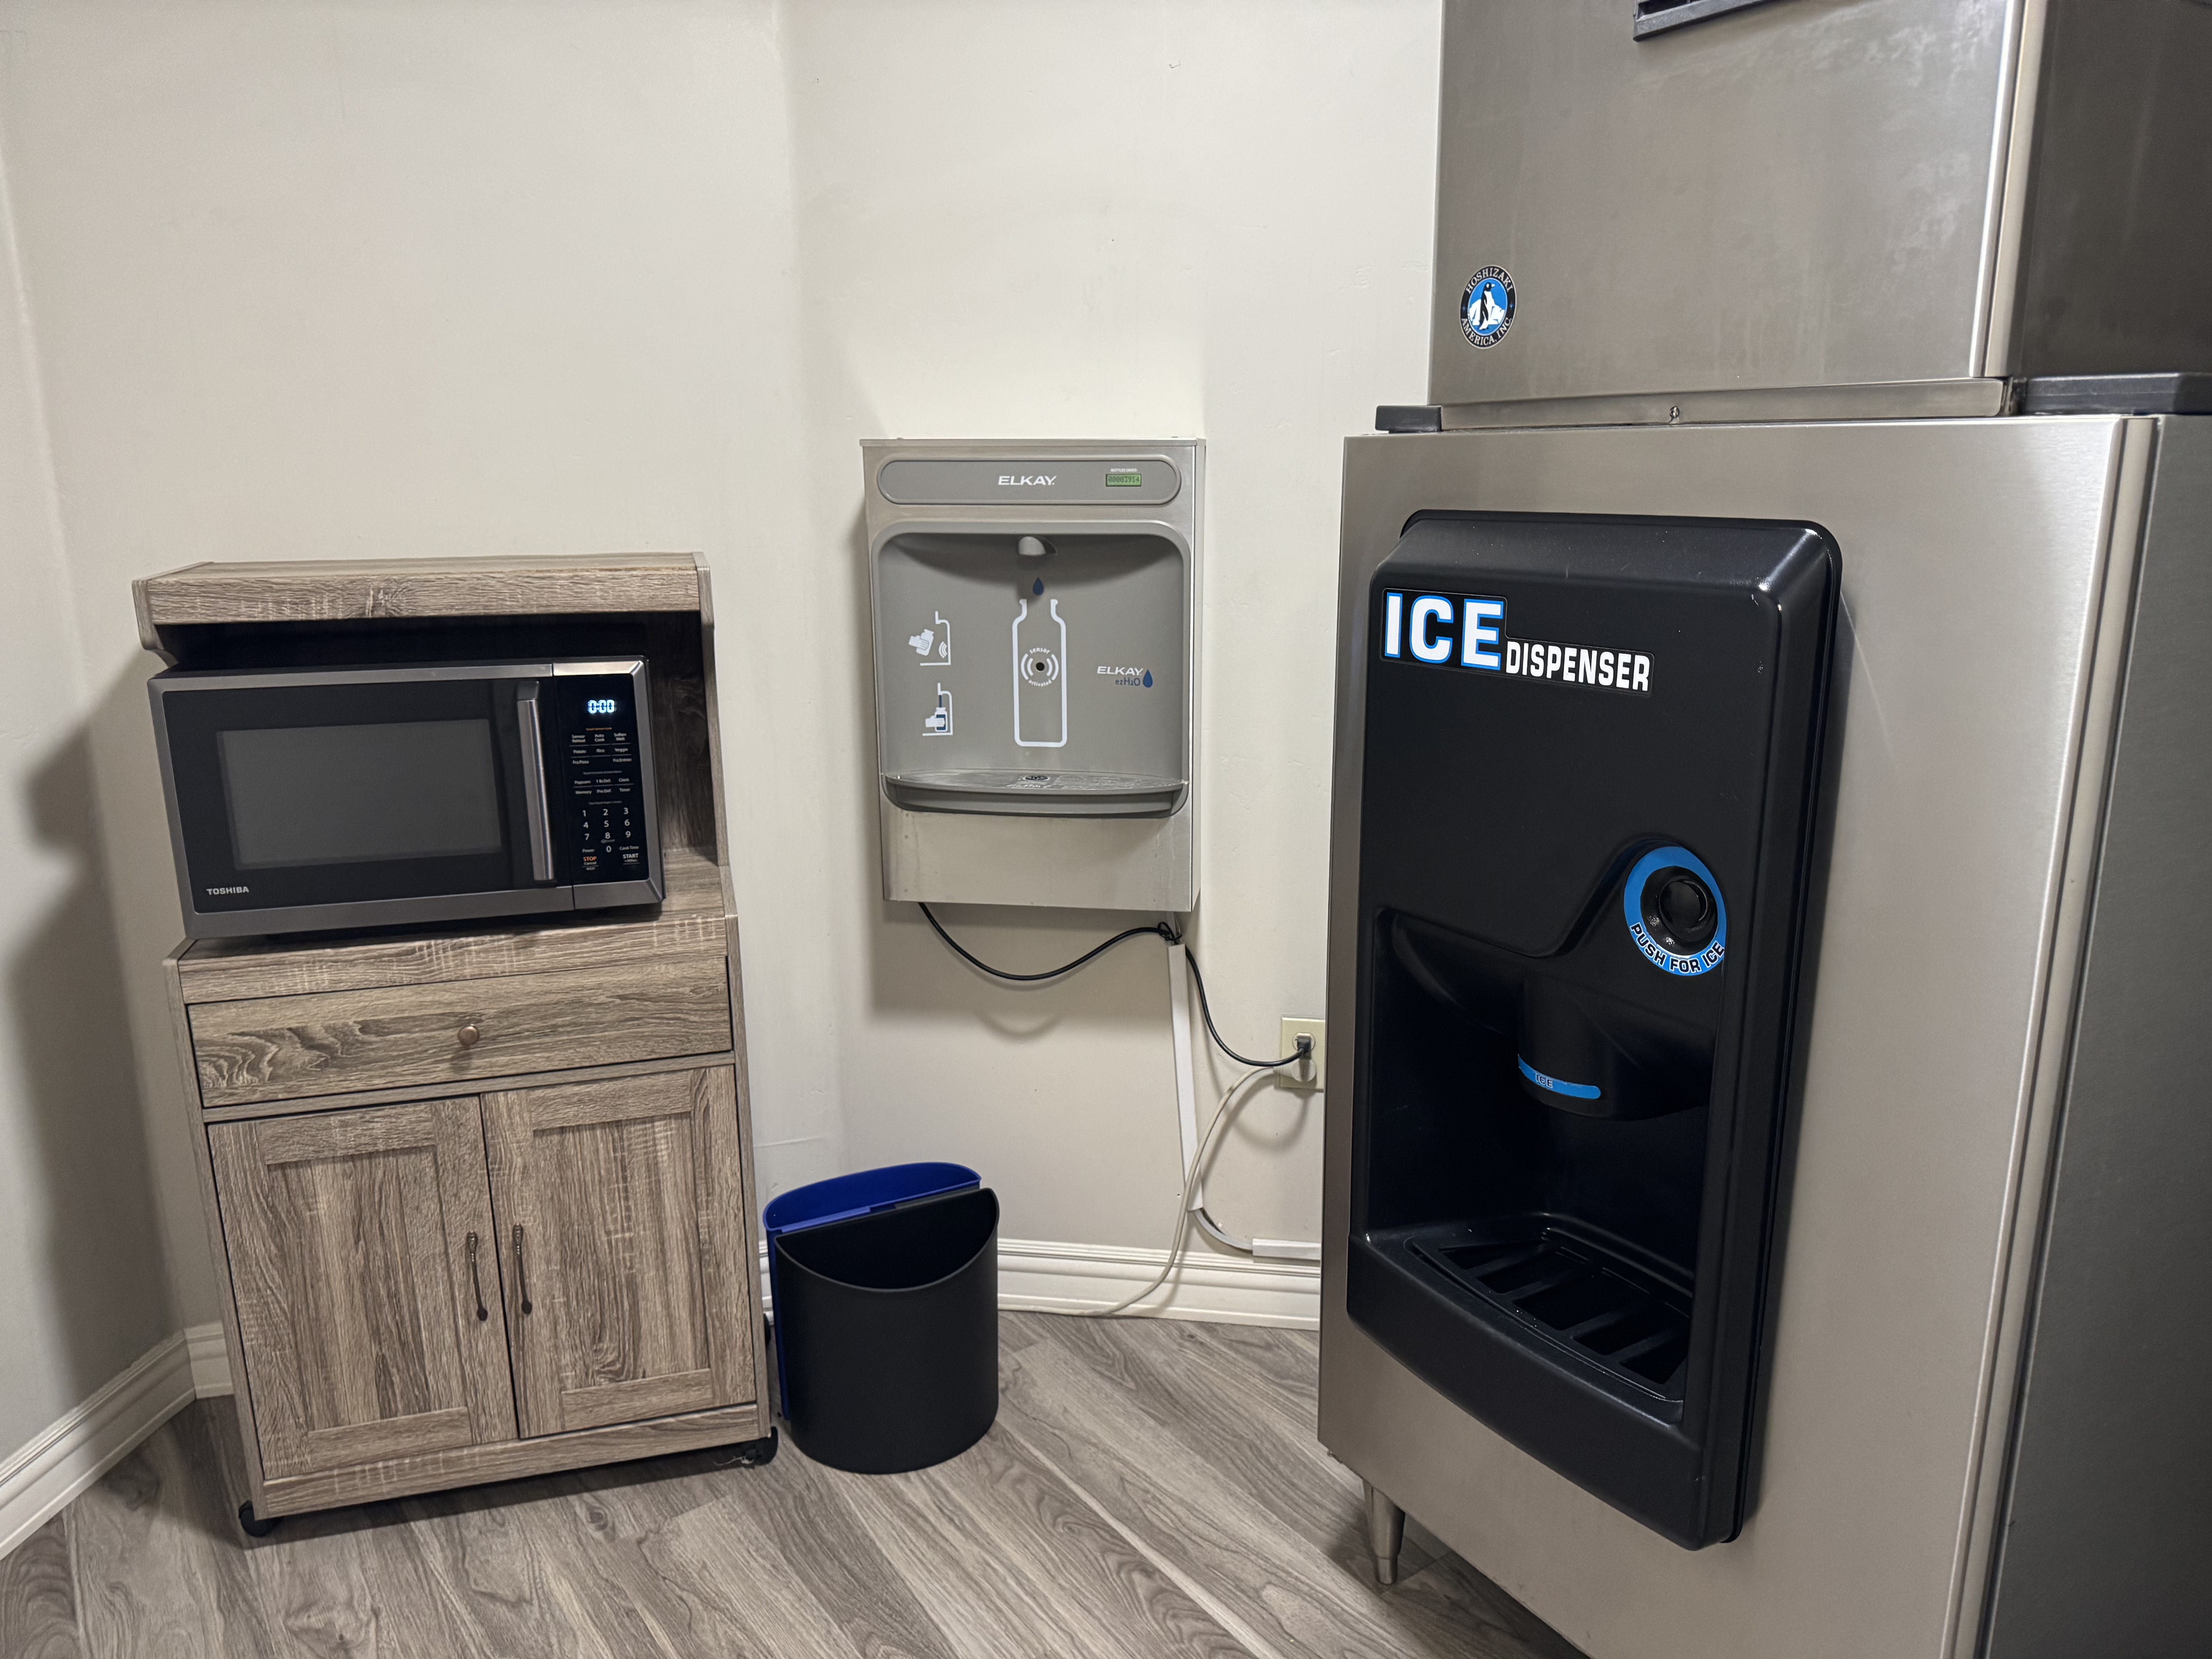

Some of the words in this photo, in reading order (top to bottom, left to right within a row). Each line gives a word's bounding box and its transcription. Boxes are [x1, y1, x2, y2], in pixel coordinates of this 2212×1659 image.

[1466, 268, 1513, 294] HOSHIZAKI
[1385, 592, 1504, 670] ICE
[1506, 641, 1650, 691] DISPENSER
[588, 699, 615, 714] 0:00
[206, 886, 249, 895] TOSHIBA
[1631, 923, 1666, 966] PUSH
[1669, 957, 1702, 972] FOR
[1702, 941, 1724, 968] ICE
[1535, 1073, 1553, 1088] ICE
